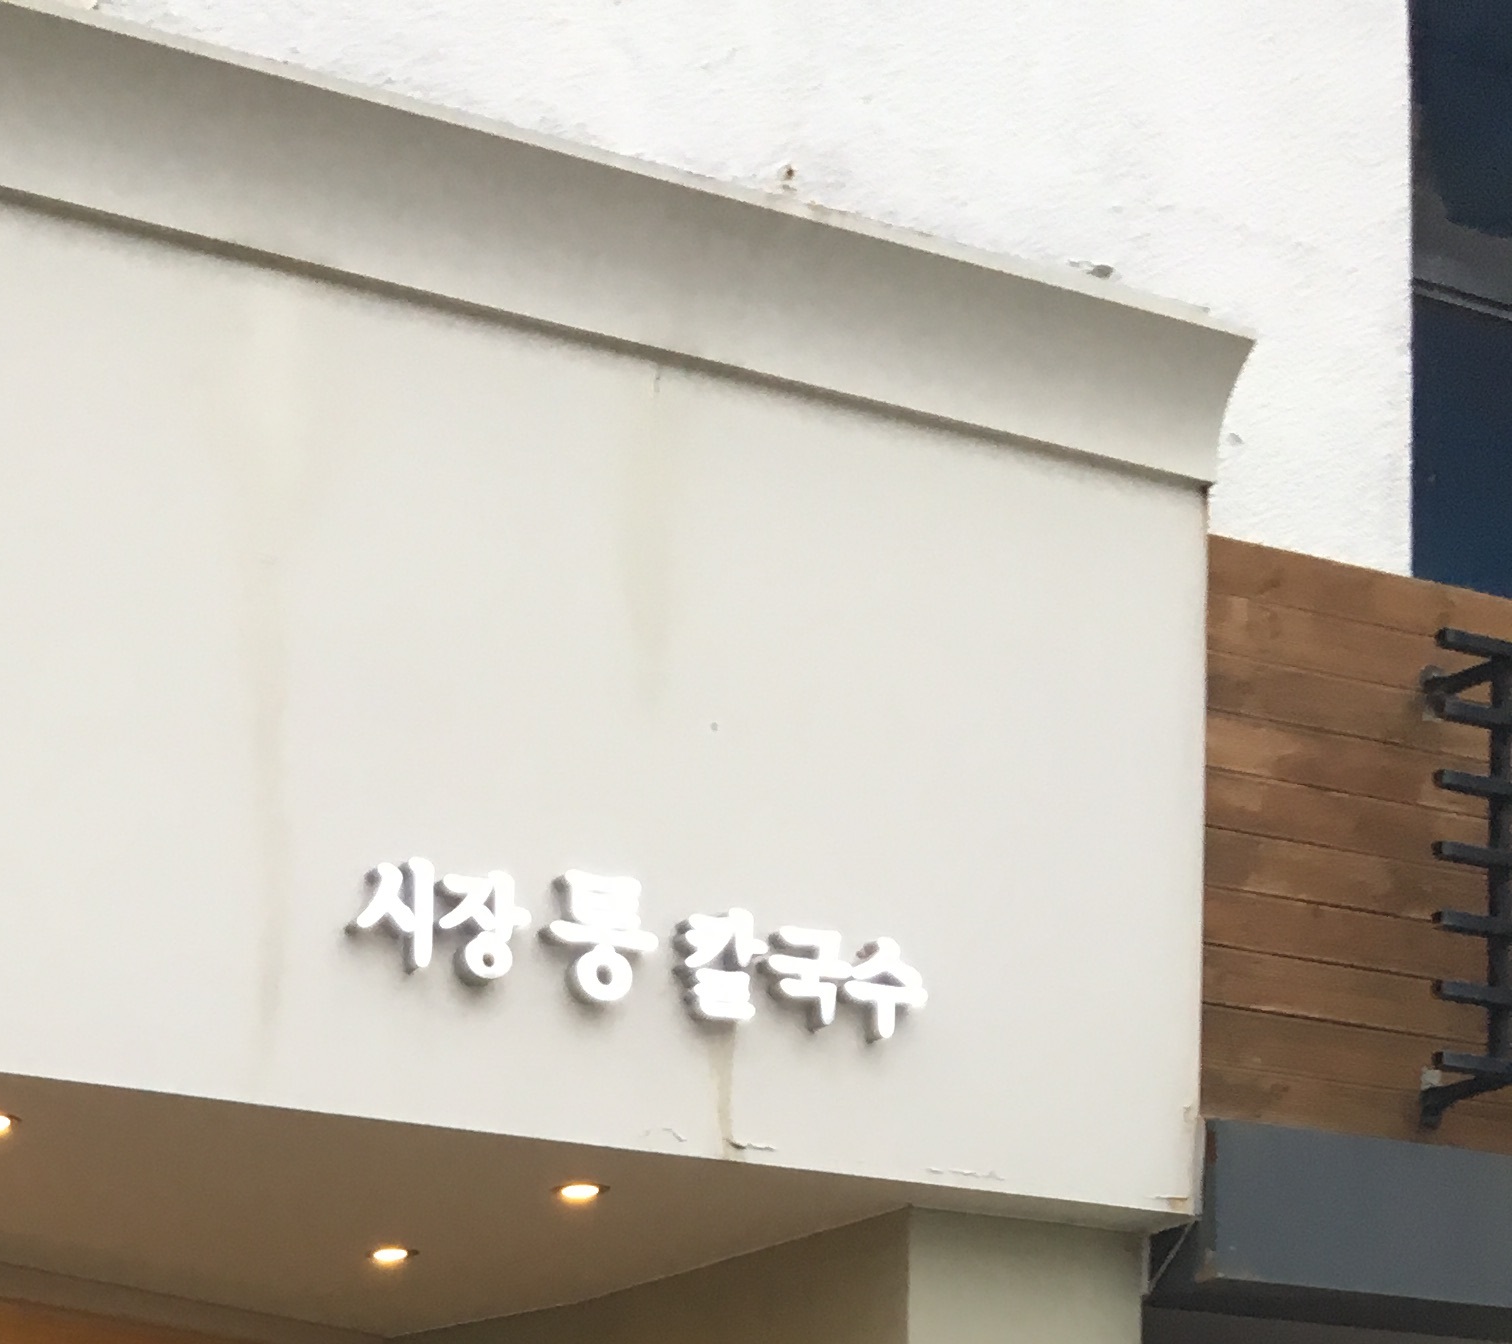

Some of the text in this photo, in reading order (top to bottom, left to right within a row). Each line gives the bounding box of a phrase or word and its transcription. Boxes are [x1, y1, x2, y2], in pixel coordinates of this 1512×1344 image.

[346, 856, 929, 1043] 시장 통 칼국수
